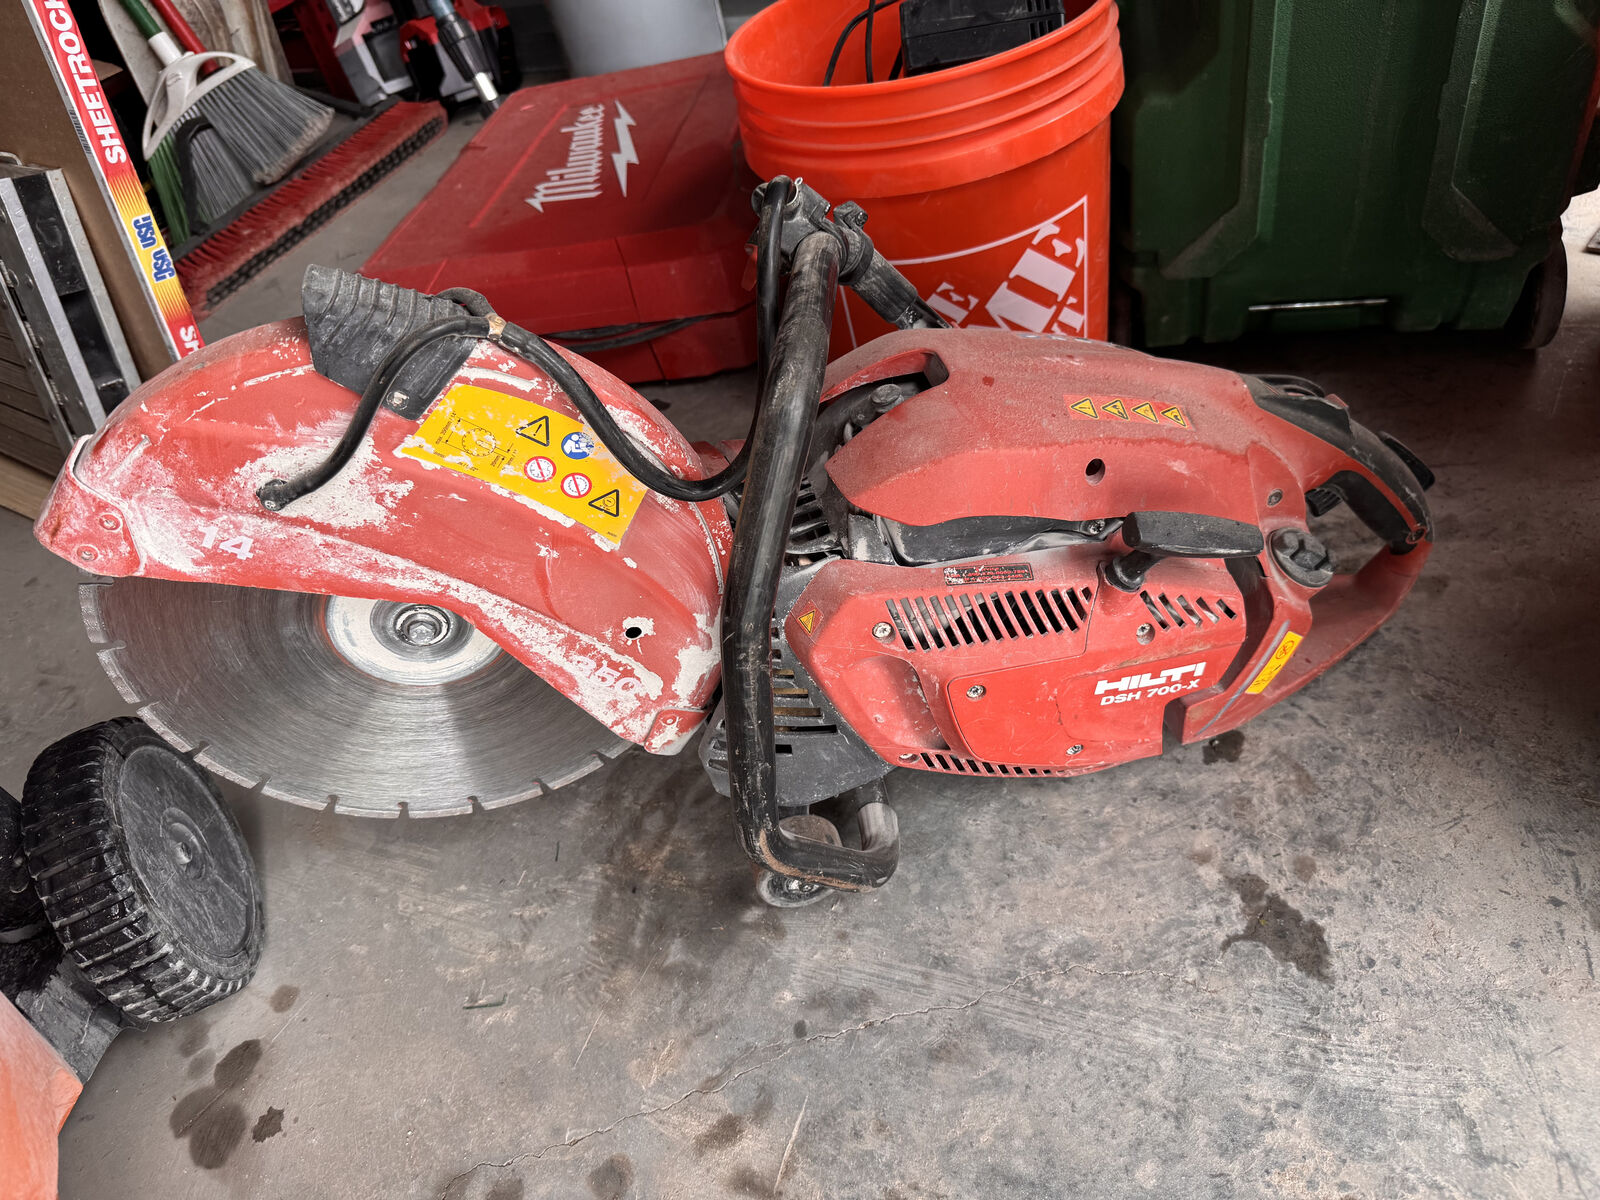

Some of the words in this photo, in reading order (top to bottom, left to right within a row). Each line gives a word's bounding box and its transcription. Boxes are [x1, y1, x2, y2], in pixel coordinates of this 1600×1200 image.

[524, 104, 605, 213] Milwaukee
[133, 213, 157, 249] USG
[152, 247, 176, 283] USG
[198, 526, 254, 560] 14
[571, 655, 643, 697] 350
[1094, 661, 1207, 695] HILTI
[1100, 690, 1142, 706] DSH
[1147, 679, 1200, 698] 700-X
